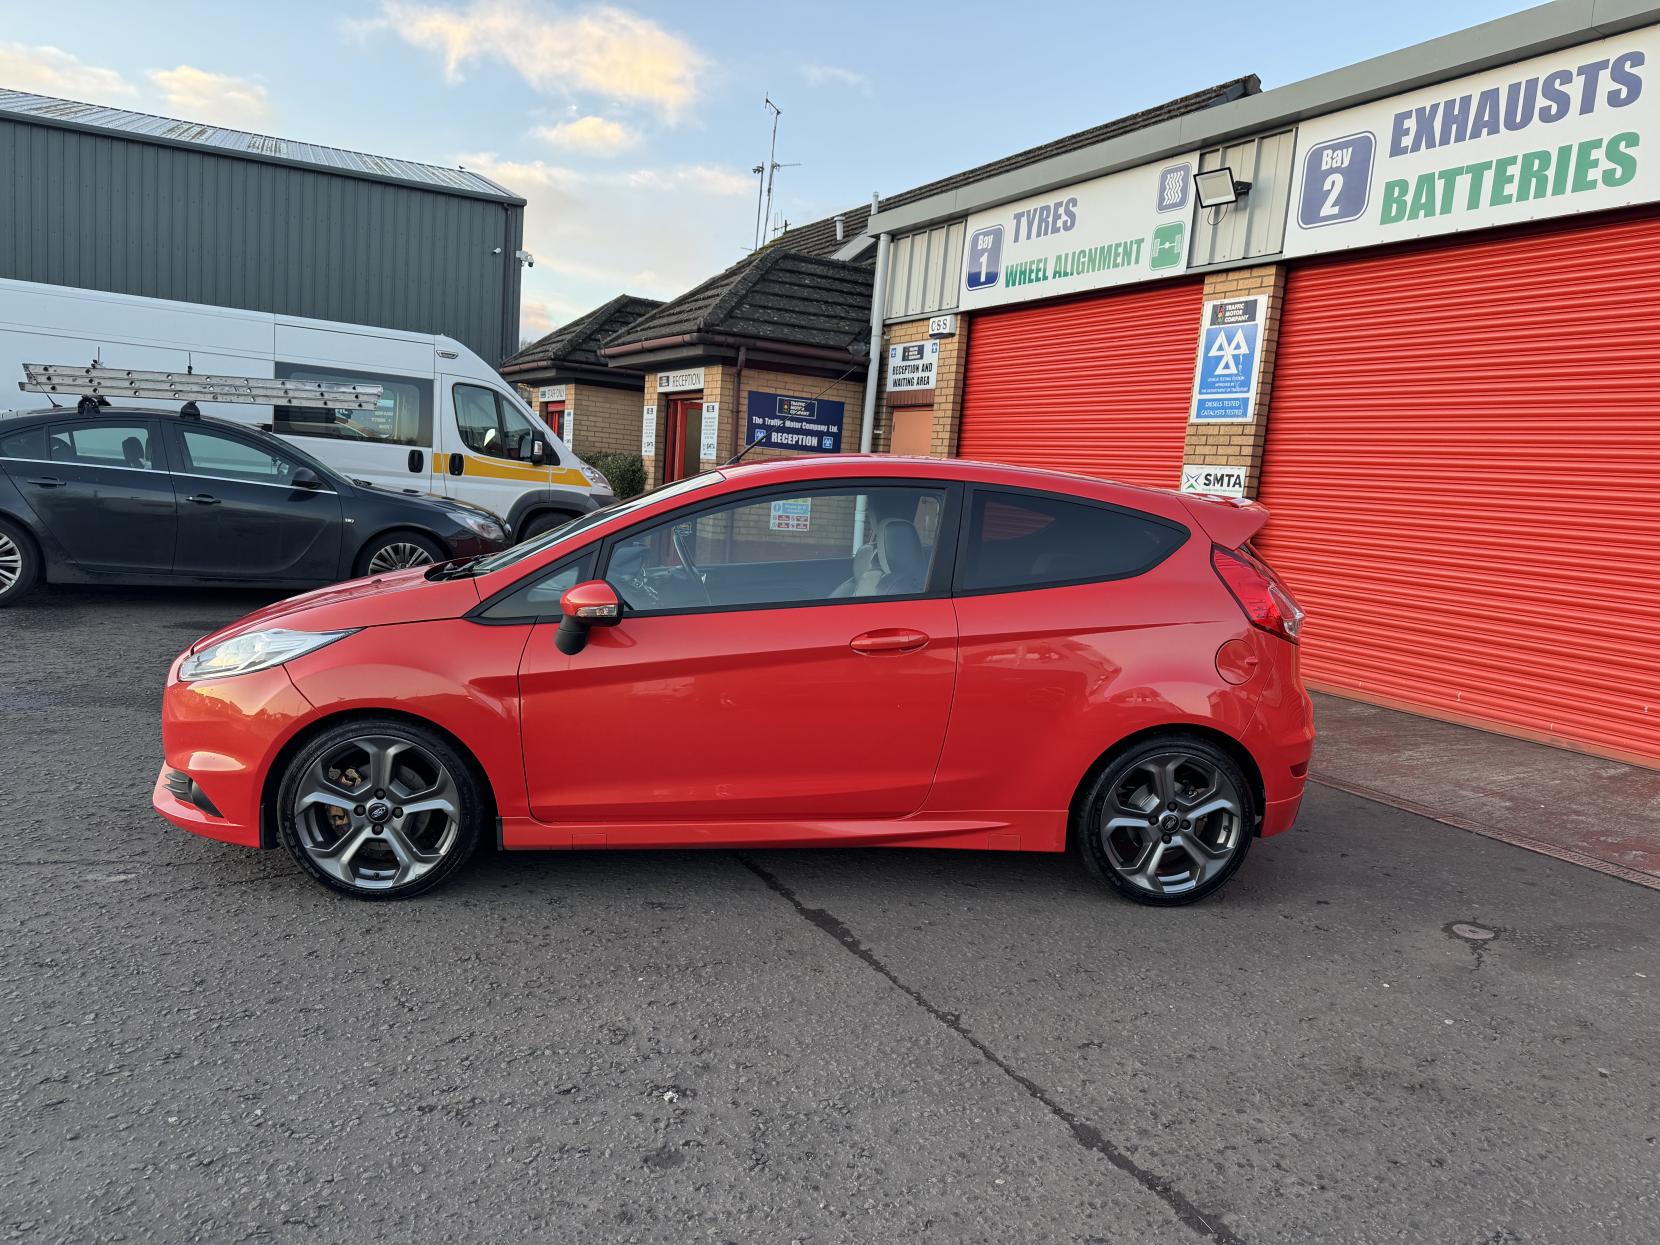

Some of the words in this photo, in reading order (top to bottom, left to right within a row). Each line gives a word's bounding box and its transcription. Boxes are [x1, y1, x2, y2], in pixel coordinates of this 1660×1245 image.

[1388, 50, 1646, 158] EXHAUSTS
[1320, 146, 1353, 171] Bay
[1379, 131, 1641, 226] BATTERIES
[1319, 173, 1344, 218] 2
[1013, 197, 1078, 243] TYRES
[977, 232, 994, 250] Bay
[979, 252, 988, 283] 1
[1004, 257, 1049, 288] WHEEL
[1052, 237, 1145, 280] ALIGNMENT
[1224, 315, 1249, 323] COMPANY
[892, 364, 919, 375] RECEPTION
[921, 362, 933, 373] AND
[672, 373, 701, 387] RECEPTION
[892, 376, 915, 388] WAITING
[916, 375, 930, 387] AREA
[752, 416, 764, 425] The
[765, 417, 783, 427] Traffic
[785, 420, 802, 429] Motor
[802, 422, 828, 432] Company
[771, 432, 818, 447] RECEPTION
[1203, 473, 1242, 488] SMTA
